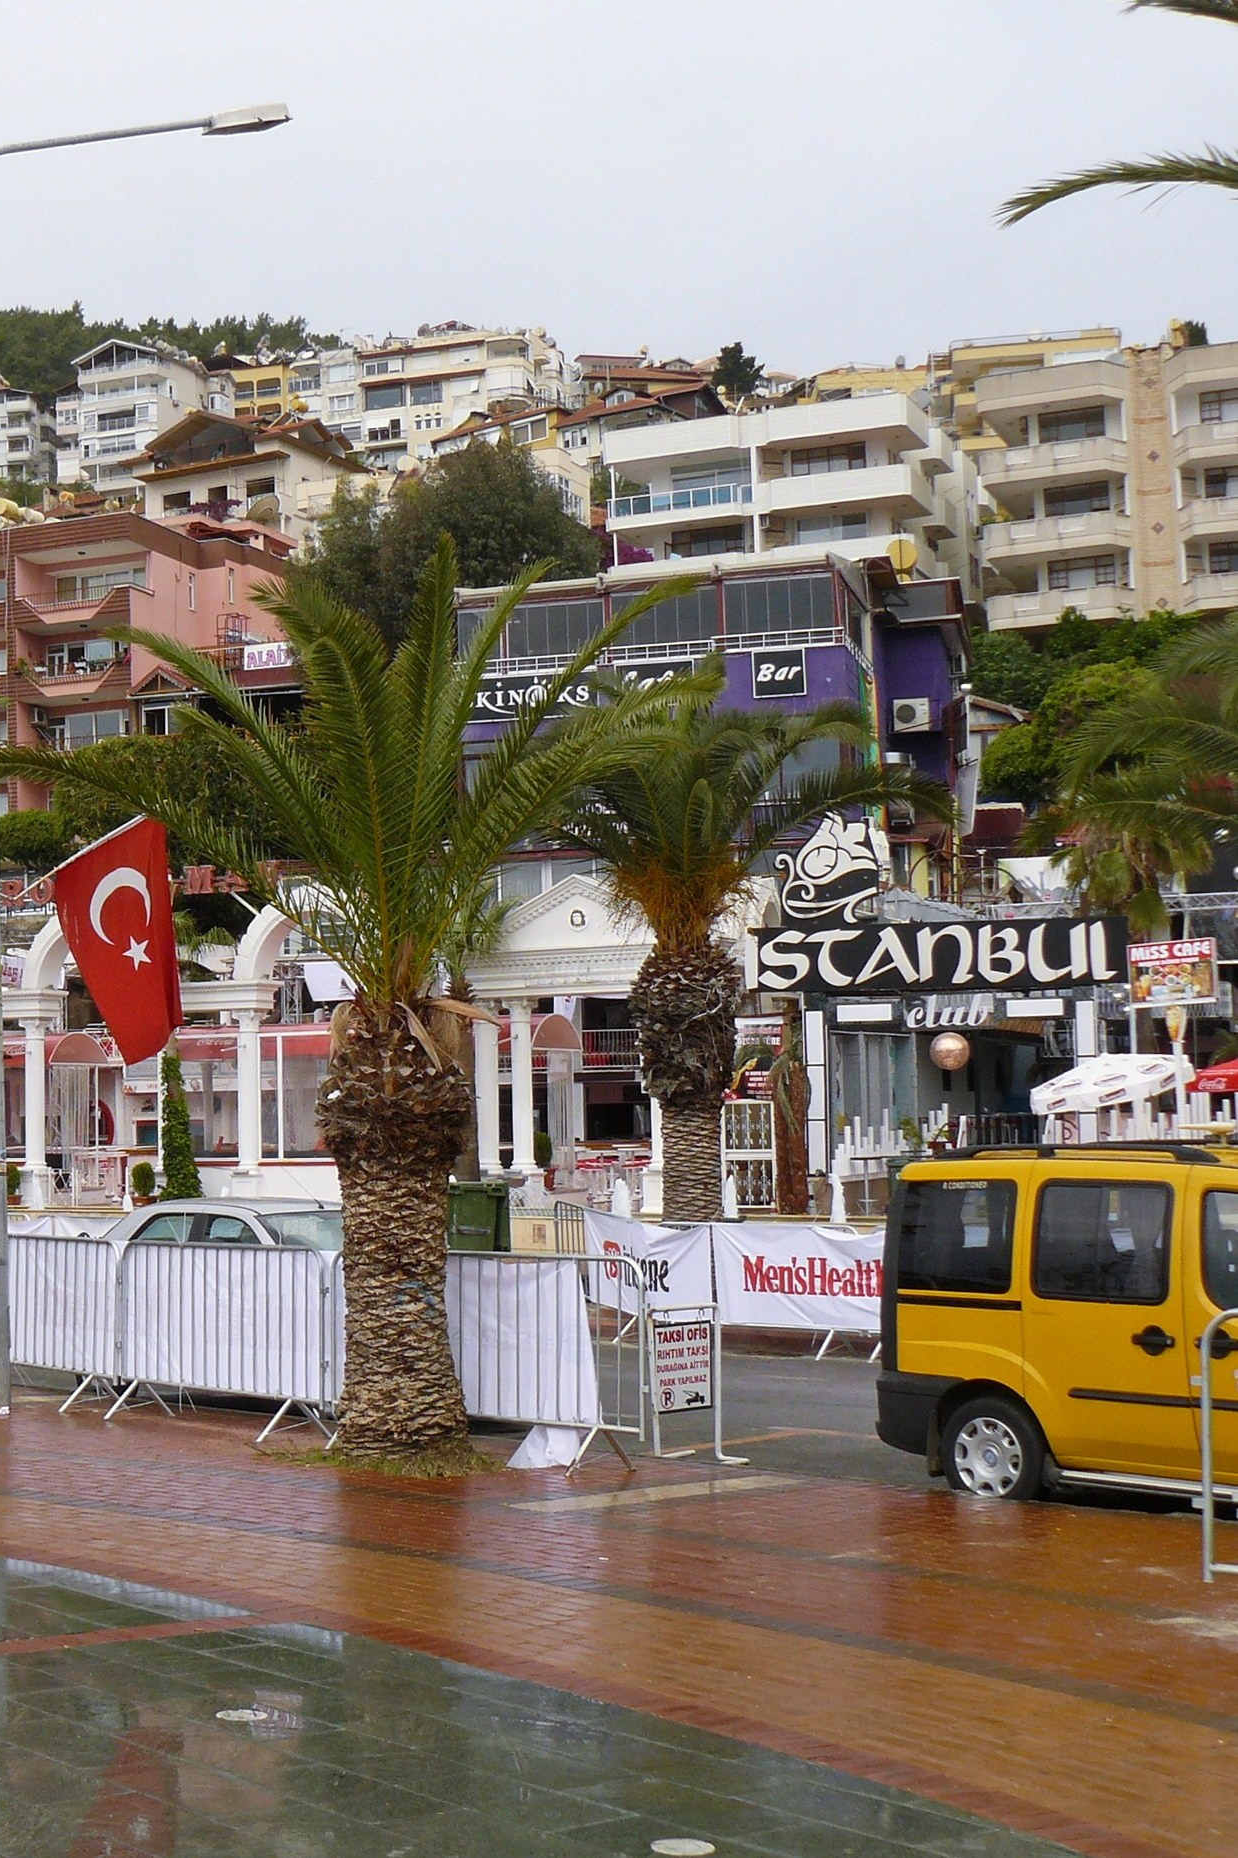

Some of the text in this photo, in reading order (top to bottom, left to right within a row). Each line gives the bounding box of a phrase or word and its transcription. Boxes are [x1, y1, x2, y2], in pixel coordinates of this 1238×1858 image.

[757, 663, 802, 683] Bar
[1172, 941, 1211, 957] CAFE
[906, 993, 990, 1029] club
[659, 1378, 676, 1388] PARK
